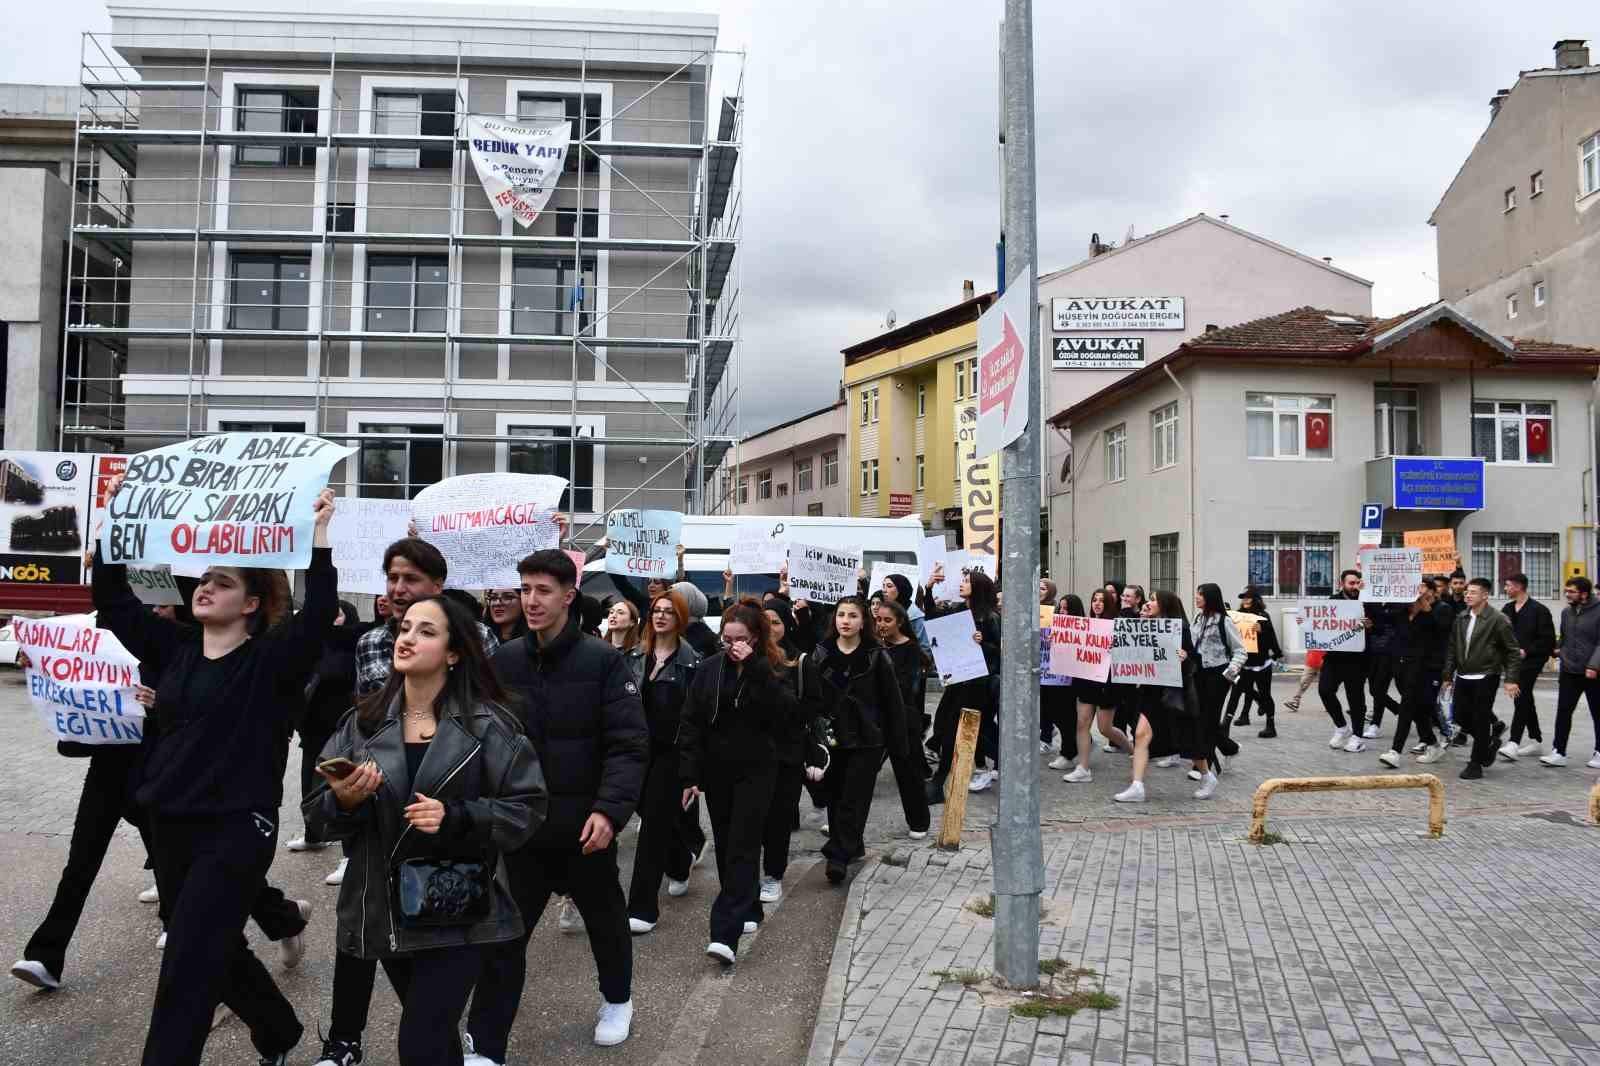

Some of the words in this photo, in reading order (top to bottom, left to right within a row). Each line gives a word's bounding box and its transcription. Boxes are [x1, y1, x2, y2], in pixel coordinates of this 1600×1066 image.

[525, 143, 562, 159] YAPI
[1066, 299, 1171, 311] AVUKAT
[1149, 311, 1180, 321] ERGEN
[1056, 338, 1142, 351] AVUKAT
[237, 436, 330, 460] ADALET
[178, 457, 289, 491] BIRAKTIM
[1364, 506, 1379, 527] P
[110, 523, 148, 560] BEN
[827, 554, 858, 569] ADALET
[13, 620, 101, 655] KADINLARI
[1076, 648, 1102, 664] KADIN
[41, 655, 132, 688] KORUYUN
